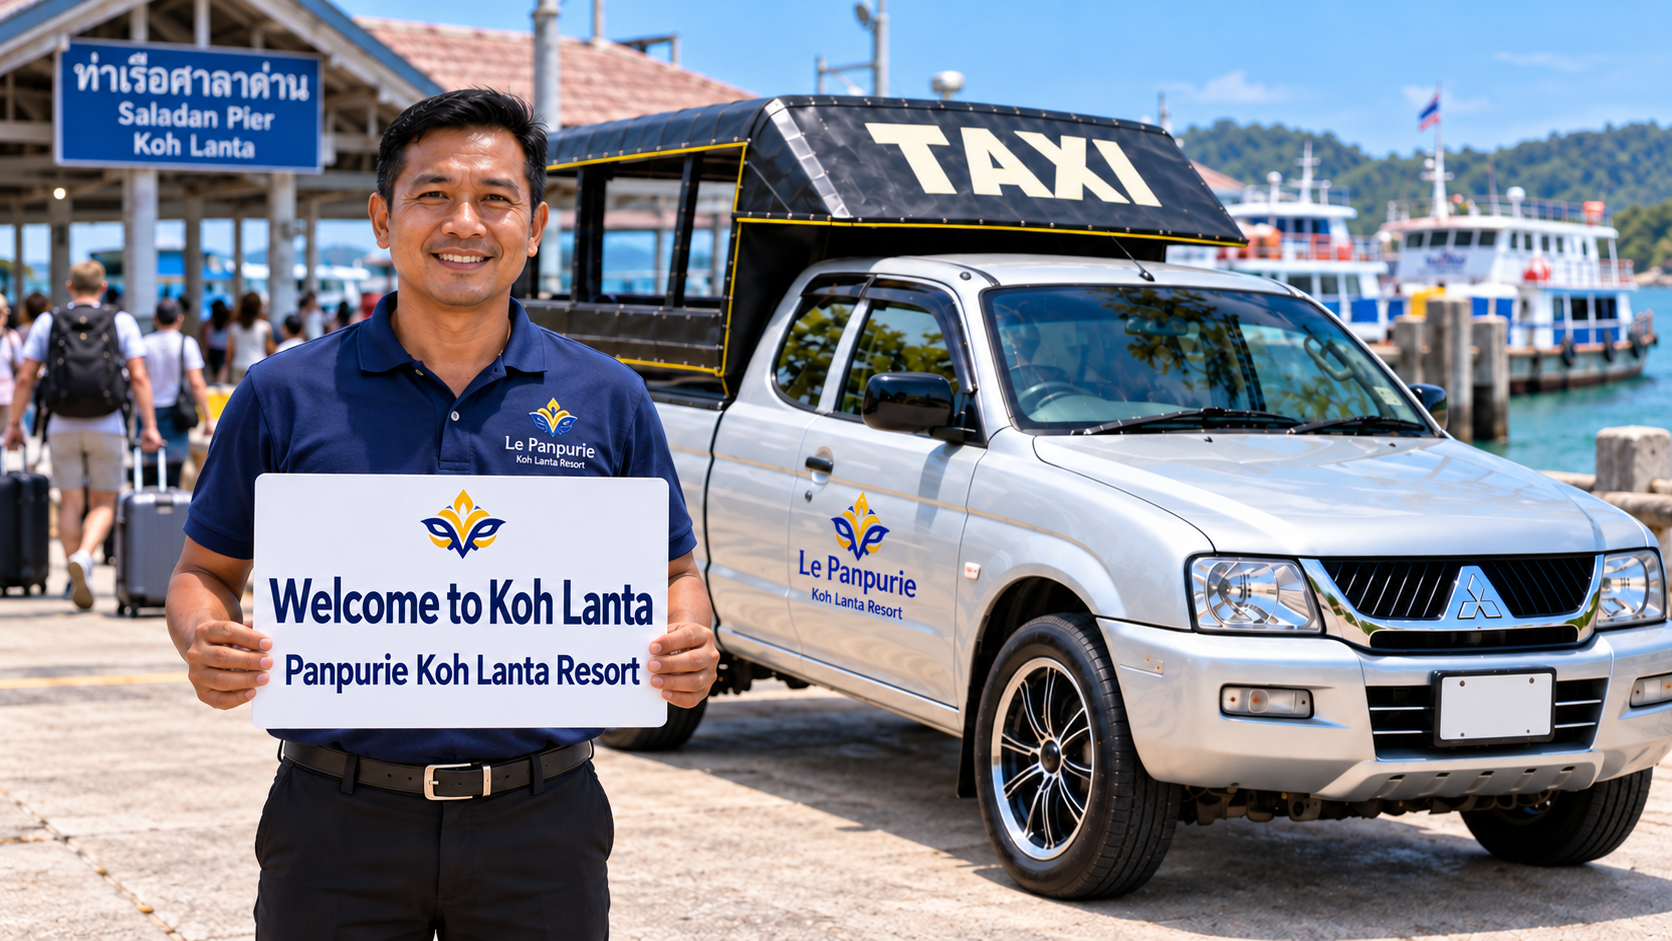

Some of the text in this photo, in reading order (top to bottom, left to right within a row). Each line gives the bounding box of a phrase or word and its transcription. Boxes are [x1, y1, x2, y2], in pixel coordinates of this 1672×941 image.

[73, 51, 310, 102] ท่าเรือศาลาด่าน
[118, 101, 275, 131] Saladan Pier
[133, 131, 255, 159] Koh Lanta
[864, 122, 1163, 208] TAXI
[505, 436, 595, 458] Le Panpurie
[516, 455, 585, 469] Koh Lanta Resort
[799, 550, 916, 598] Le Panpurie
[269, 576, 653, 626] Welcome to Koh Lanta
[811, 587, 903, 620] Koh Lanta Resort
[285, 652, 640, 694] Panpurie Koh Lanta Resort
